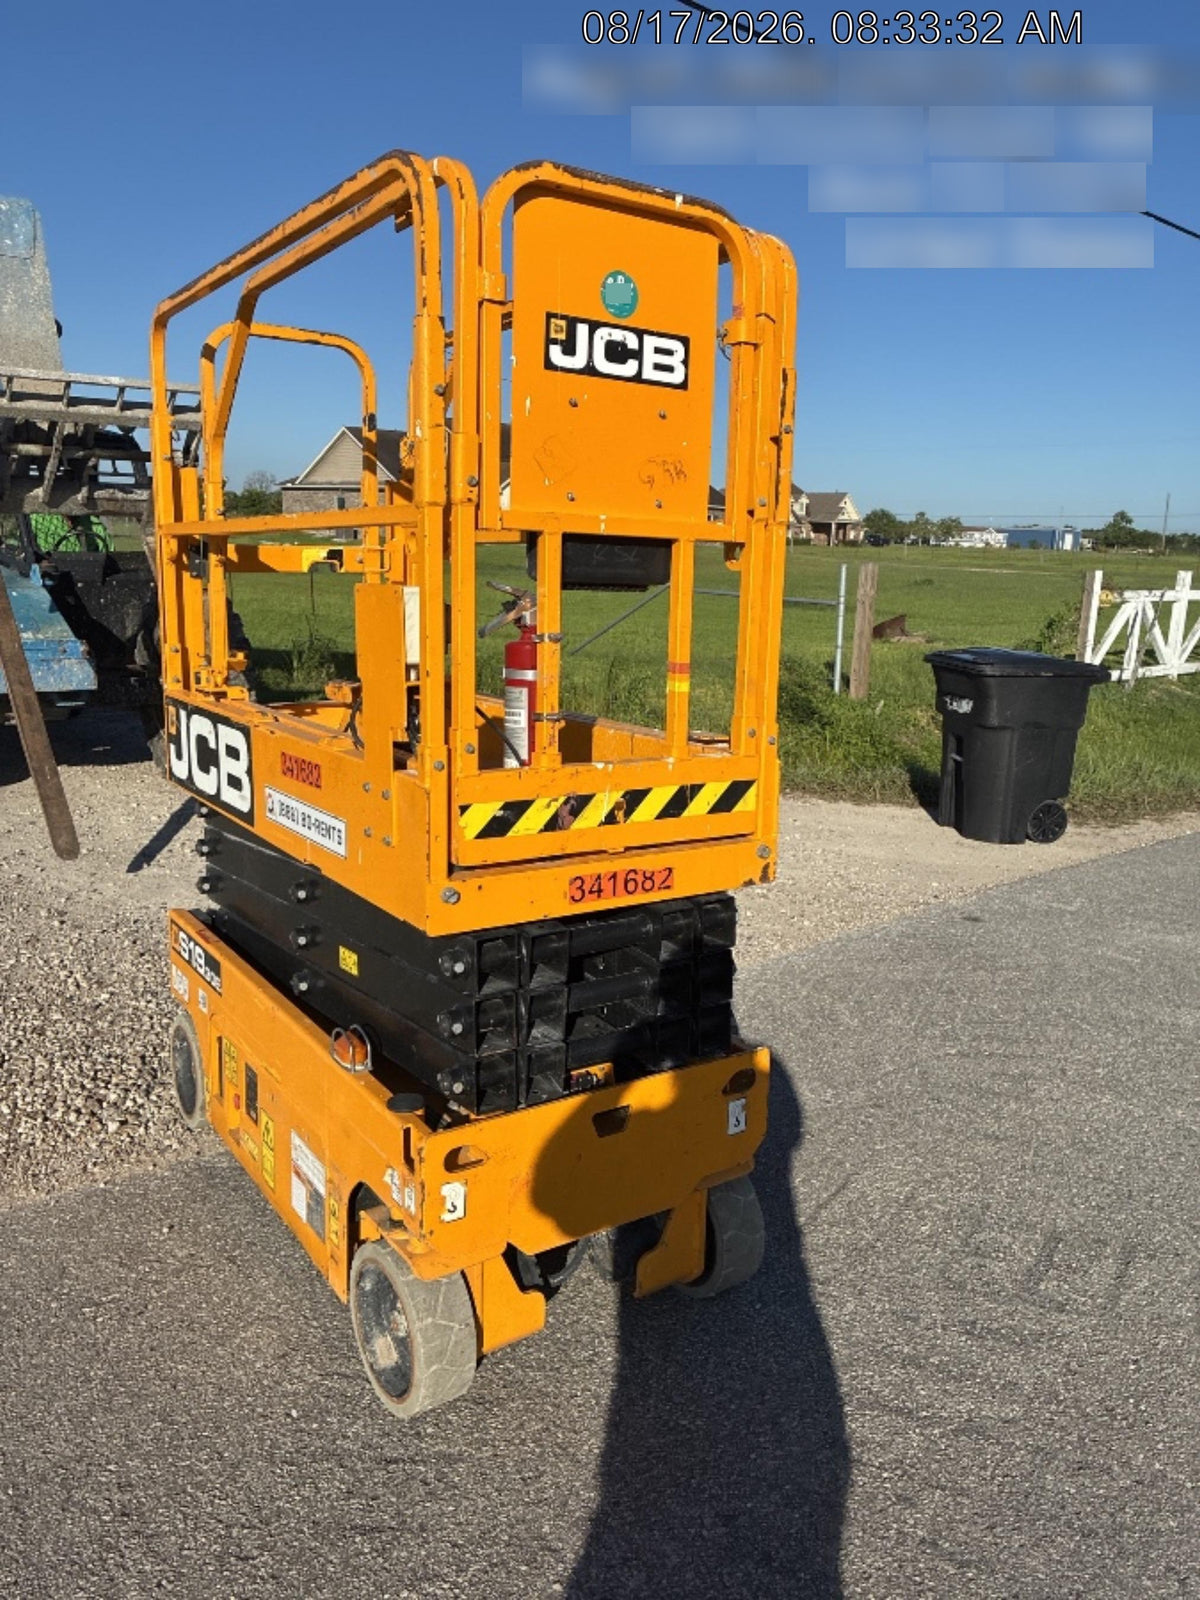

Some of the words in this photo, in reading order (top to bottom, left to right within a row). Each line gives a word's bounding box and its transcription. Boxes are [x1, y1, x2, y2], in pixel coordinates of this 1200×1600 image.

[549, 322, 686, 384] JCB
[170, 708, 252, 813] JCB
[281, 752, 321, 788] 341682
[570, 867, 673, 902] 341682
